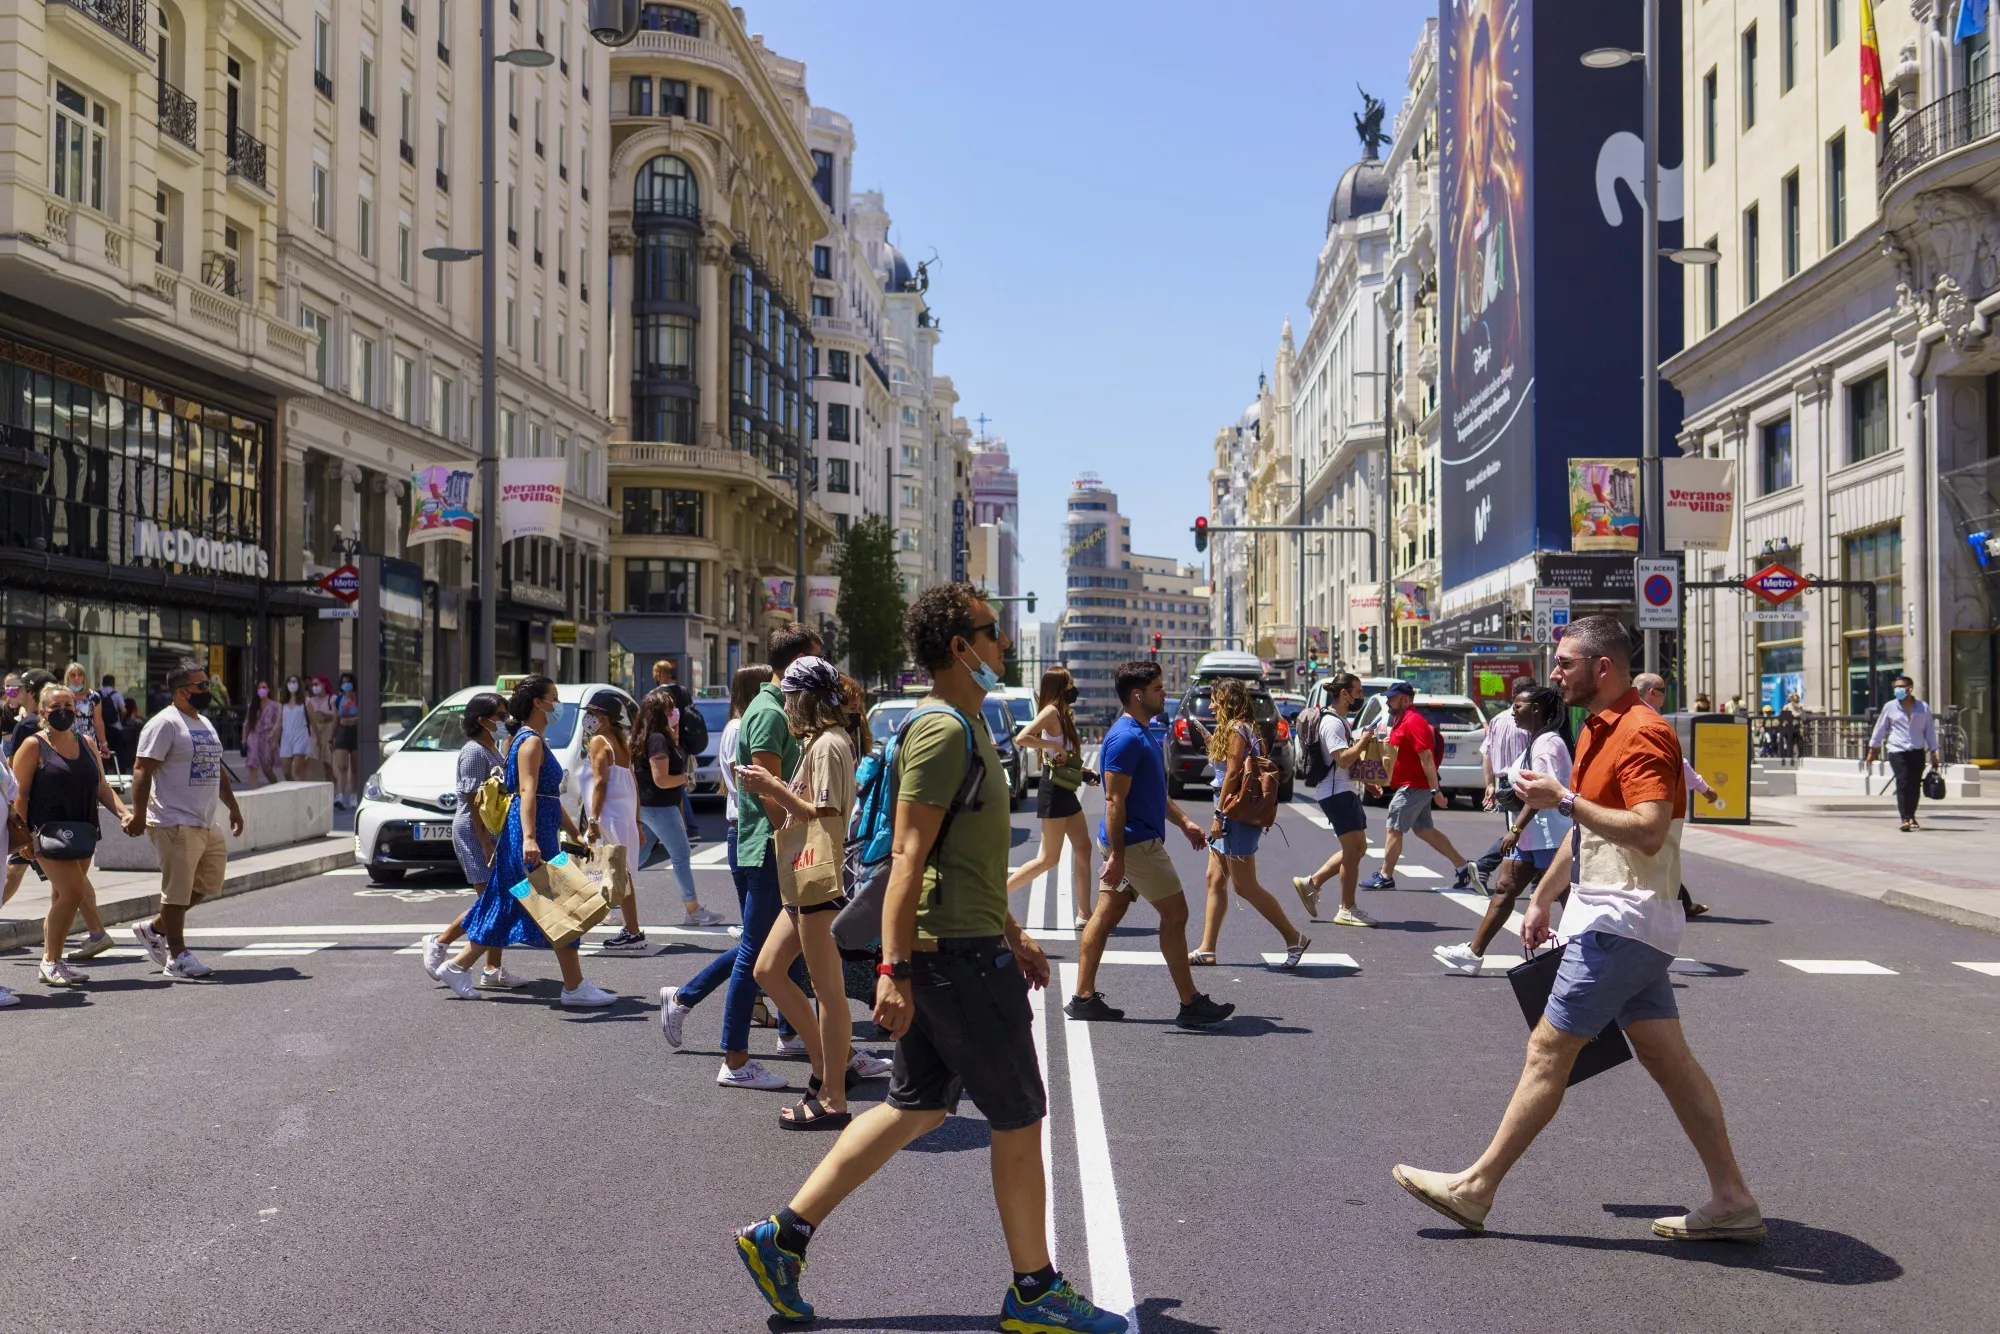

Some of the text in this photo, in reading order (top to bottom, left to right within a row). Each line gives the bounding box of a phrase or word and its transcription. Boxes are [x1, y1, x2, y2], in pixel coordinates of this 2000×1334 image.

[503, 483, 562, 496] Veranos
[1669, 489, 1732, 501] Veranos
[519, 492, 554, 503] Villa
[1667, 500, 1677, 508] de
[1678, 500, 1687, 508] la
[1688, 501, 1725, 513] Villa
[134, 519, 268, 579] McDonald's
[334, 578, 359, 587] Metro
[1763, 578, 1793, 588] Metro
[332, 609, 351, 617] Gran
[791, 847, 815, 872] H&M
[1042, 1307, 1069, 1322] Columbia
